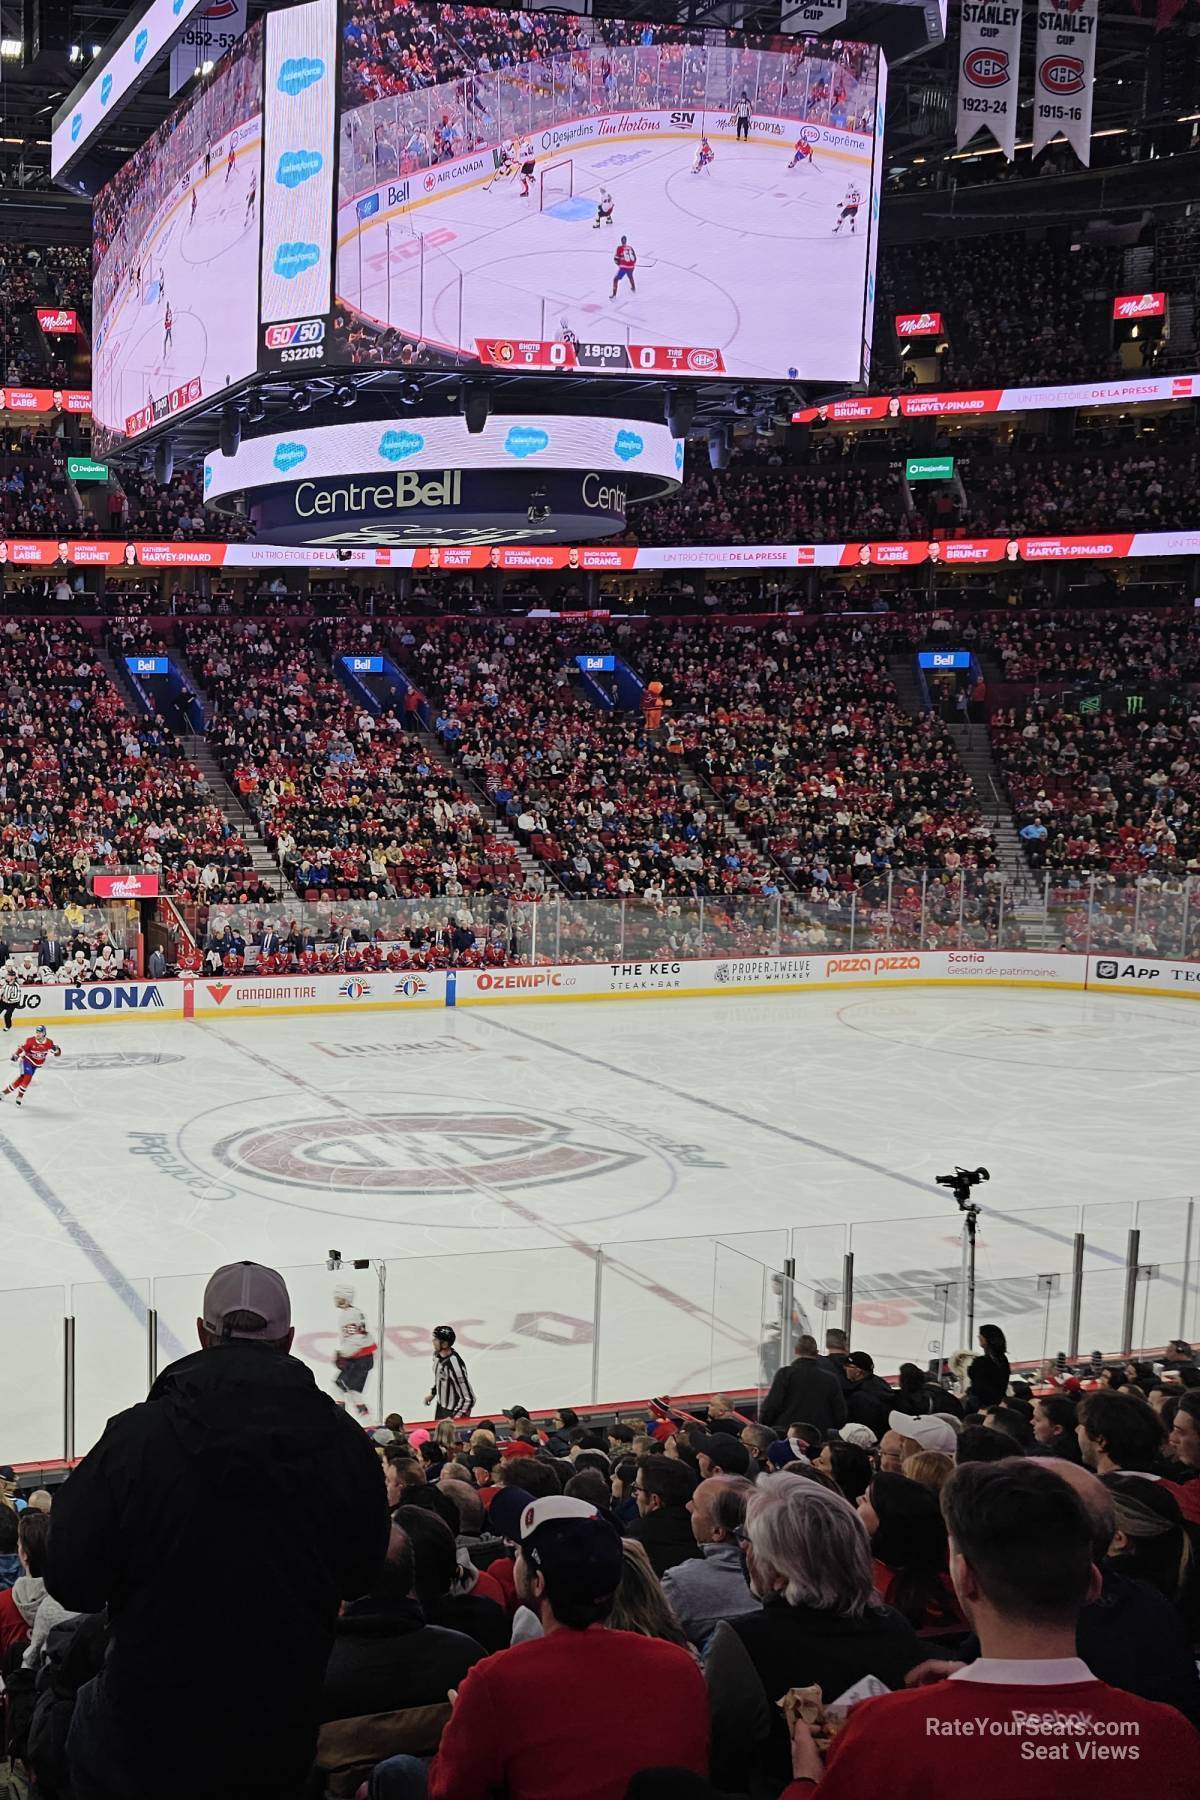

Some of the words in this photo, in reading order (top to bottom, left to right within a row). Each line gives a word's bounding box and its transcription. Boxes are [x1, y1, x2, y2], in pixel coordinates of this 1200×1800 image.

[803, 9, 824, 21] CUP
[962, 6, 1019, 27] STANLEY
[1039, 12, 1094, 34] STANLEY
[182, 30, 236, 48] 1952-53
[980, 27, 999, 38] CUP
[1056, 34, 1075, 46] CUP
[283, 68, 321, 81] salesforce
[962, 98, 1007, 115] 1923-24
[1038, 104, 1082, 121] 1915-16
[670, 112, 695, 124] SN
[599, 120, 616, 136] Tim
[618, 117, 660, 134] Hortons
[553, 124, 594, 147] Desjardins
[823, 132, 865, 150] Suprême
[281, 161, 319, 173] salesforce
[437, 172, 451, 185] AIR
[452, 160, 484, 181] CANADA
[388, 181, 410, 207] Bell
[1118, 297, 1160, 316] Molson
[41, 313, 73, 329] Molson
[899, 317, 936, 334] Molson
[272, 327, 292, 345] 50
[300, 323, 320, 341] 50
[519, 343, 540, 351] SHOTS
[584, 345, 621, 358] 19:03
[281, 346, 324, 362] 53220$
[550, 344, 565, 364] 0
[640, 348, 655, 368] 0
[1122, 384, 1159, 396] PRESSE
[834, 406, 873, 417] BRUNET
[907, 400, 984, 413] HARVEY-PINARD
[918, 464, 950, 473] Desjardins
[582, 472, 626, 515] Centr
[358, 524, 557, 536] Centre
[74, 551, 110, 561] BRUNET
[142, 552, 212, 562] HARVEY-PINARD
[756, 552, 787, 561] PRESSE
[947, 549, 988, 559] BRUNET
[1027, 545, 1113, 557] HARVEY-PINARD
[444, 555, 471, 564] PRATT
[584, 557, 622, 566] LORANGE
[137, 658, 156, 671] Bell
[354, 658, 372, 671] Bell
[587, 658, 605, 670] Bell
[933, 655, 955, 666] Bell
[947, 952, 985, 964] Scotia
[611, 965, 643, 976] THE
[650, 963, 681, 975] KEG
[826, 958, 871, 977] pizza
[874, 956, 921, 975] pizza
[947, 965, 983, 976] Gestion
[985, 966, 998, 976] de
[1000, 966, 1058, 978] patrimoine
[732, 974, 760, 982] IRISH
[765, 972, 811, 981] WHISKEY
[611, 982, 647, 990] STEAK
[657, 980, 681, 988] BAR
[65, 985, 165, 1011] RONA
[236, 987, 291, 1000] CANADIAN
[294, 986, 317, 998] TIRE
[1012, 1710, 1097, 1730] Reebok
